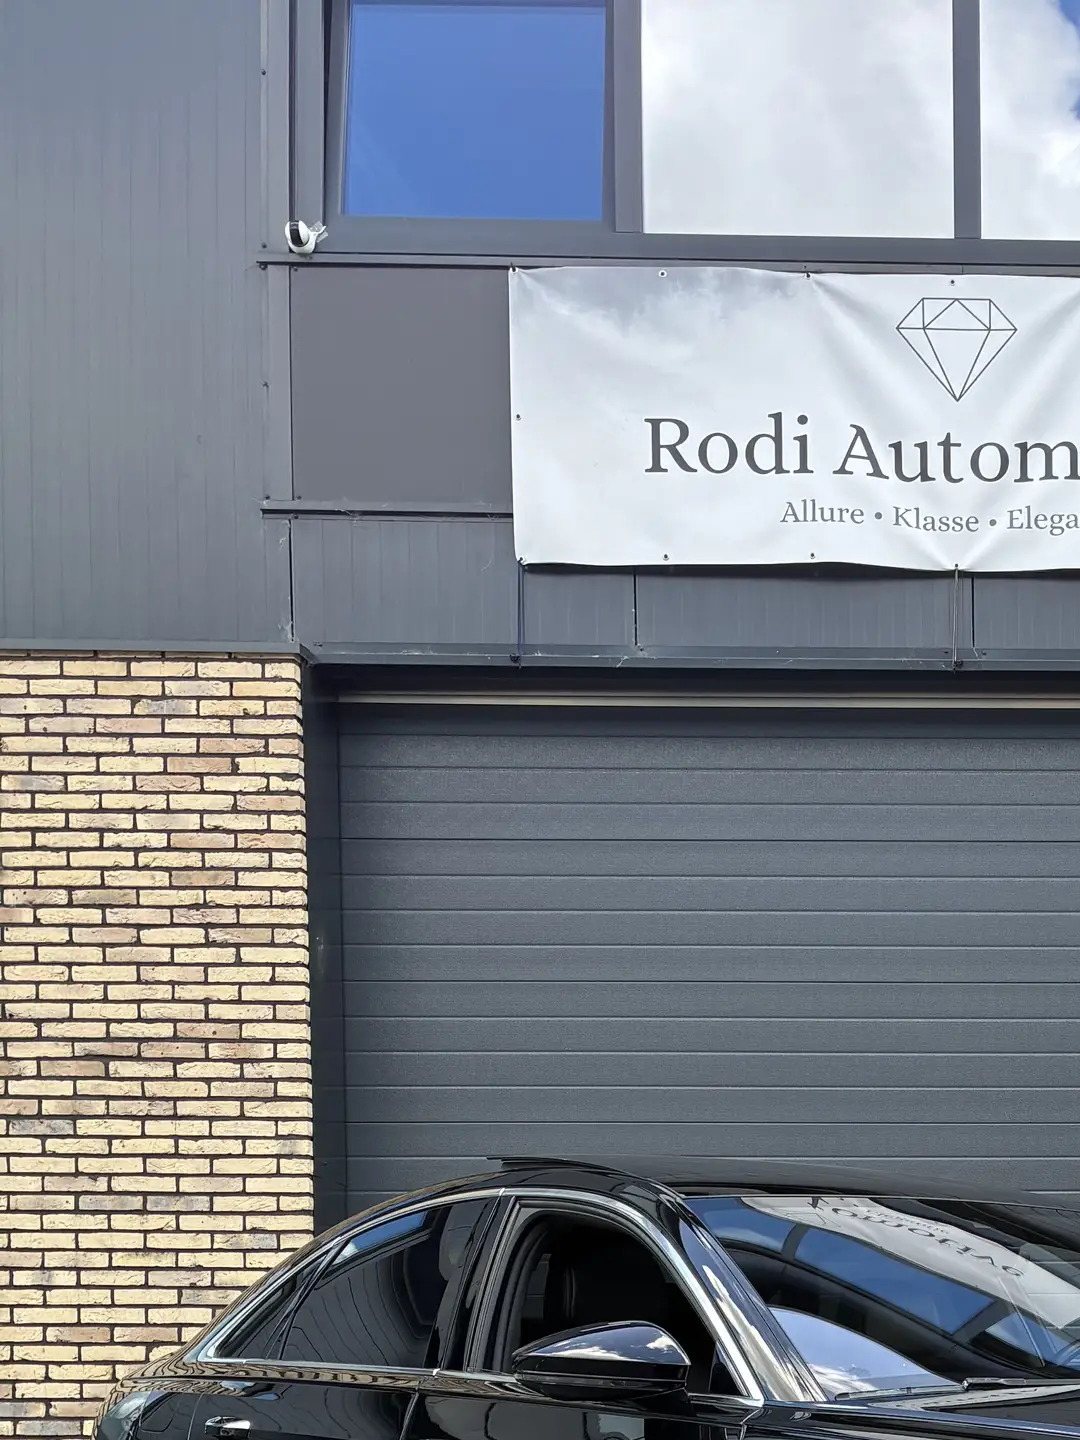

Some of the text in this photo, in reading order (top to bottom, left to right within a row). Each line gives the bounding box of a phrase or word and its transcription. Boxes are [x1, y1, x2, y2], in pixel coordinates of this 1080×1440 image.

[644, 411, 814, 475] Rodi
[779, 498, 865, 526] Allure
[892, 506, 980, 533] Klasse
